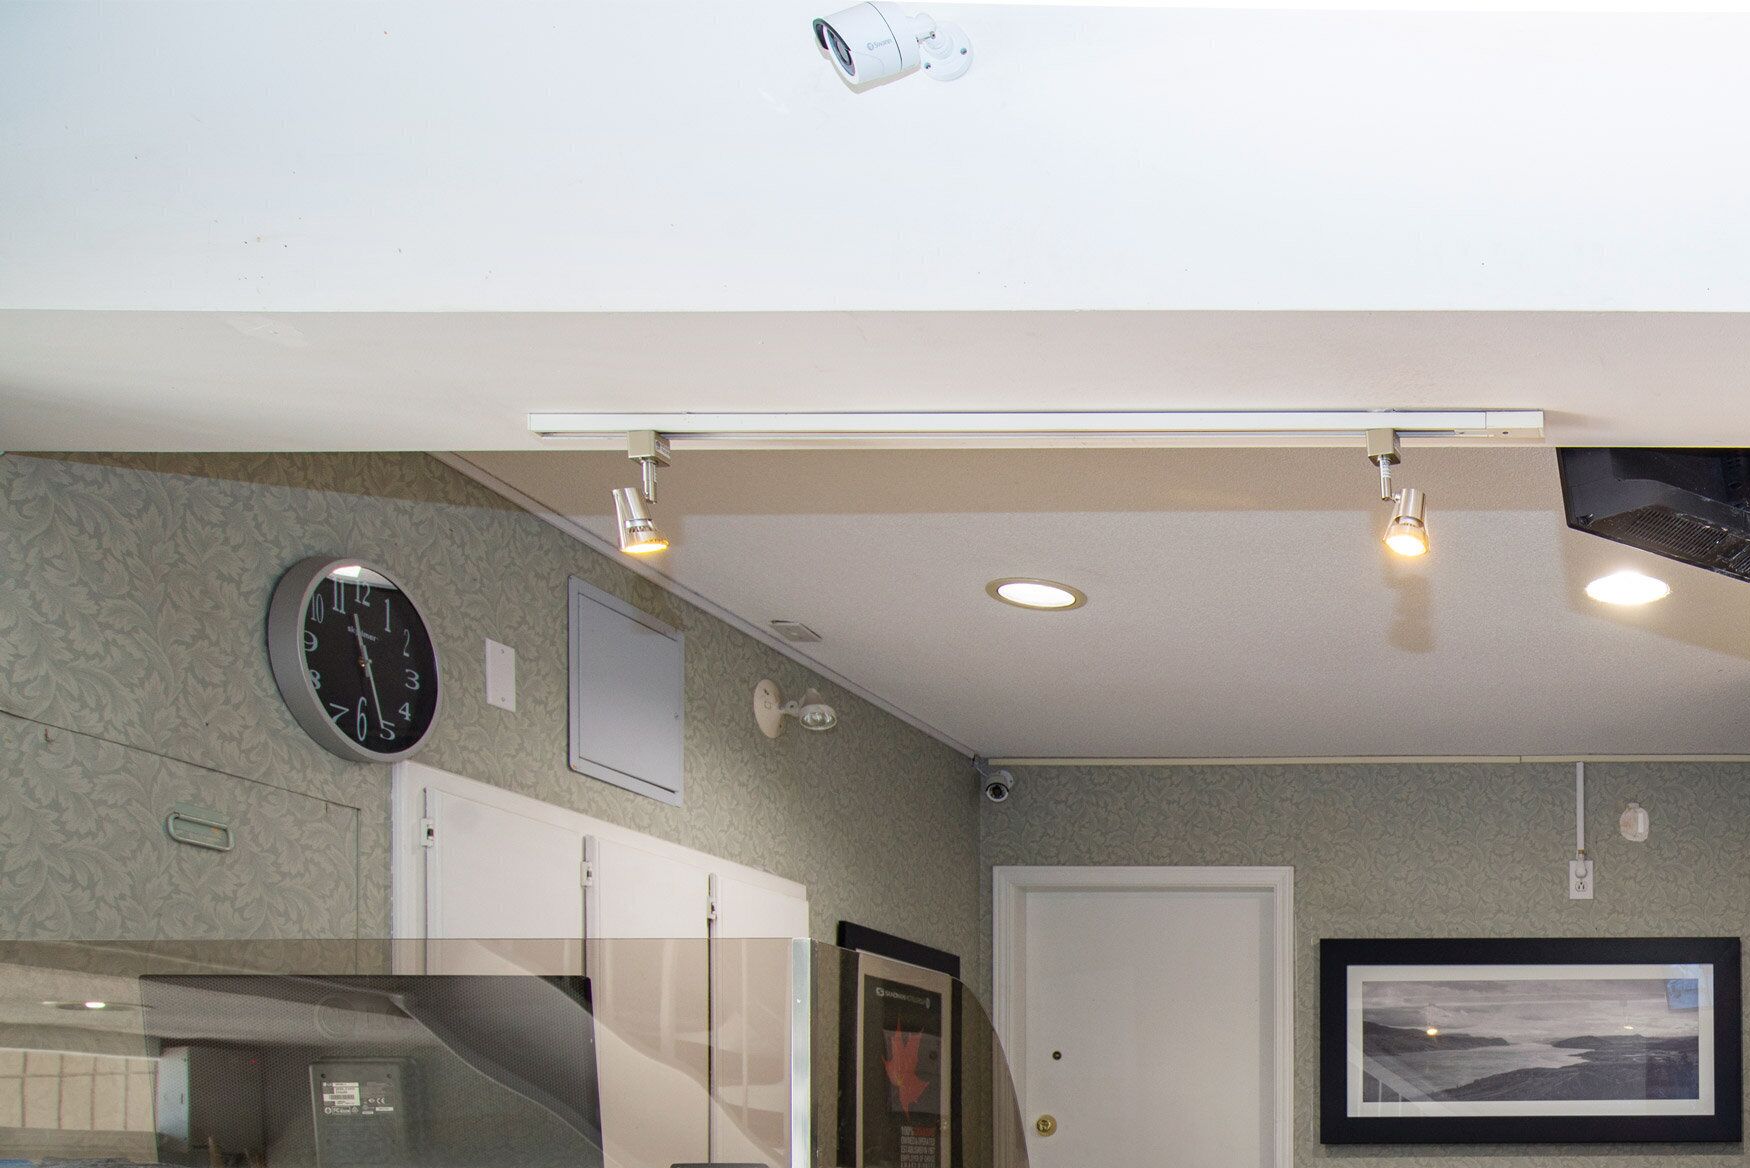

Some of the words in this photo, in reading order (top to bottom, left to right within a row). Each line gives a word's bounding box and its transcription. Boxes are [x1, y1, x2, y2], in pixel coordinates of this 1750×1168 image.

[310, 594, 324, 624] 10
[384, 598, 391, 633] 1
[304, 630, 318, 651] 9
[403, 628, 411, 657] 2
[405, 669, 420, 690] 3
[329, 702, 349, 724] 7
[356, 696, 367, 742] 6
[398, 702, 411, 721] 4
[380, 720, 396, 741] 5
